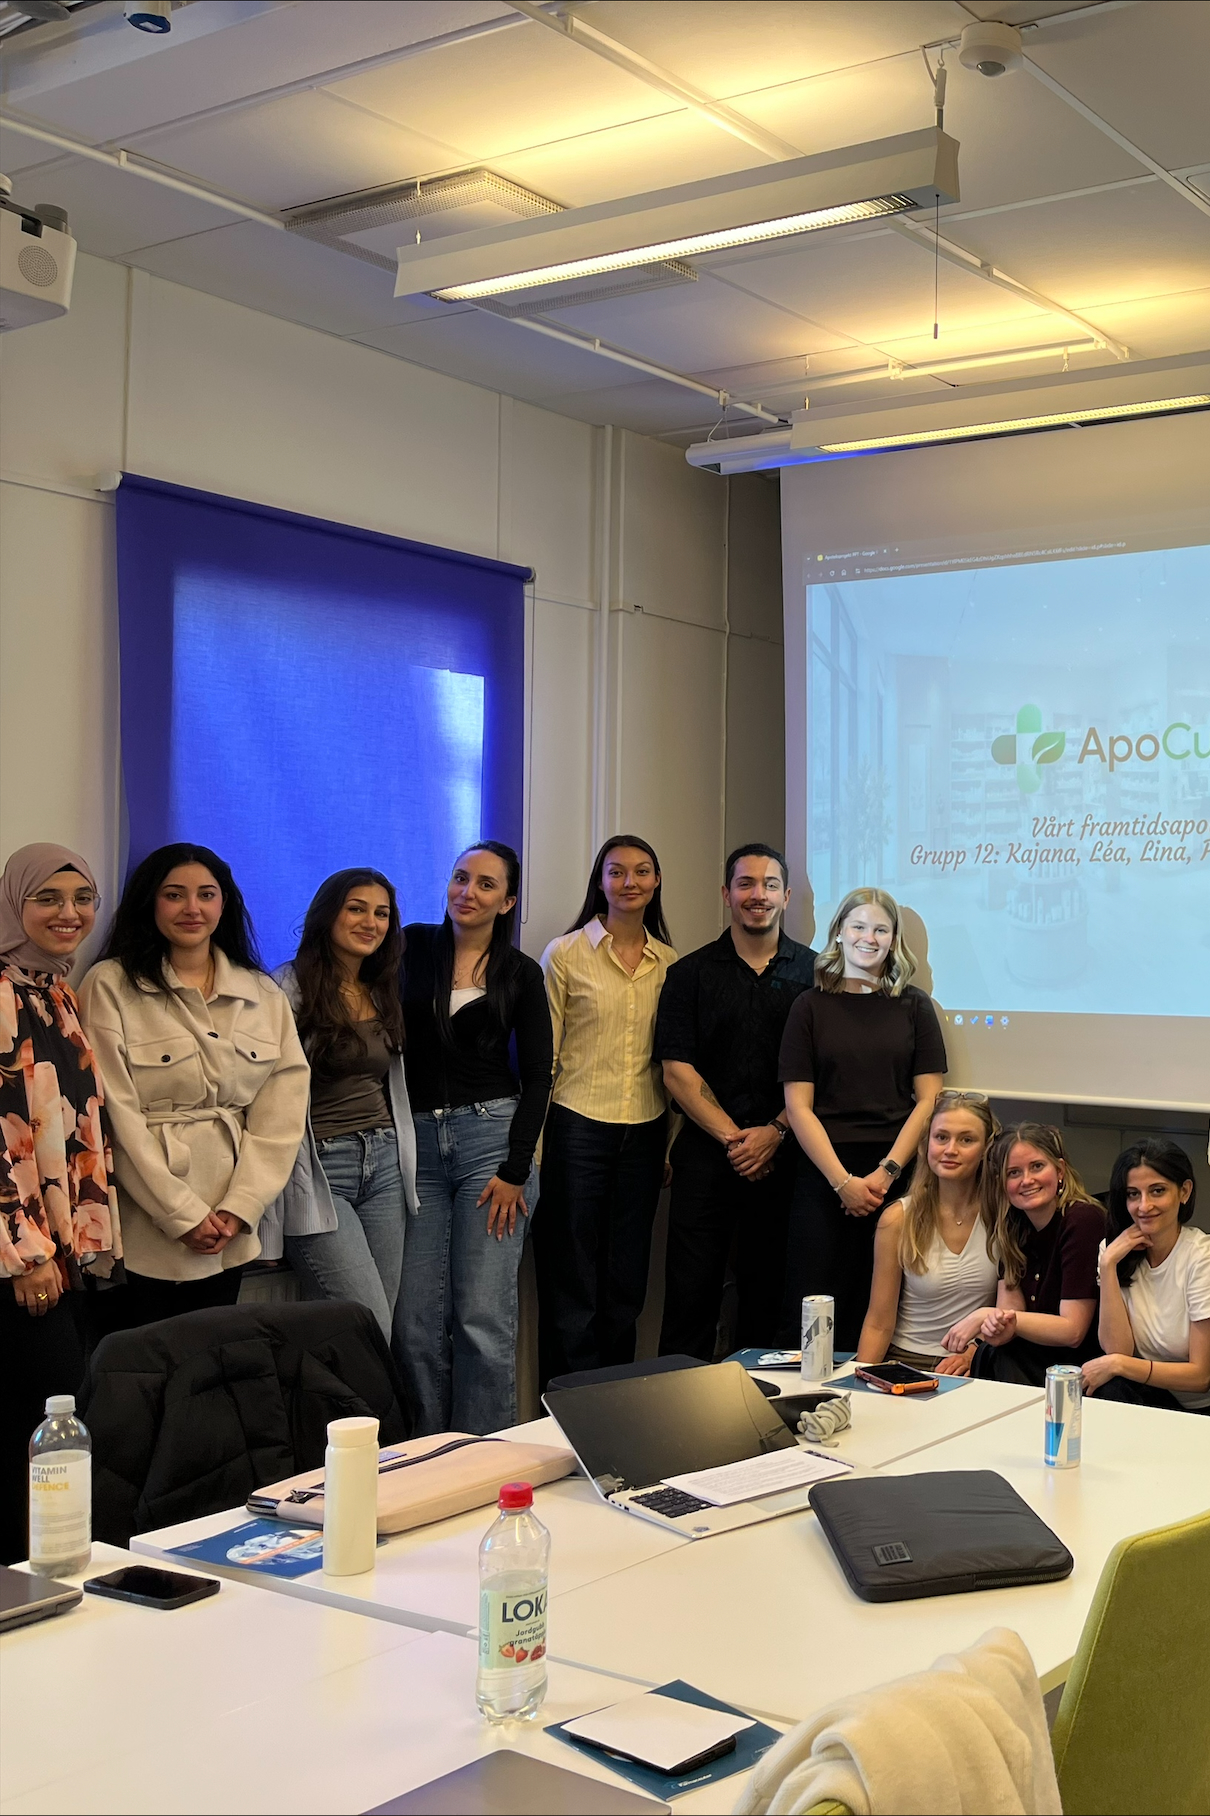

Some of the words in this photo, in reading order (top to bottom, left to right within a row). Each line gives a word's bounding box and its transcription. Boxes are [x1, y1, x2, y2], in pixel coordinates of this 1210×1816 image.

[1032, 816, 1075, 838] Vårt
[910, 844, 967, 871] Grupp
[974, 843, 999, 864] 12:
[1005, 842, 1081, 870] Kajana,
[1089, 839, 1131, 865] Léa,
[1140, 839, 1192, 865] Lina,
